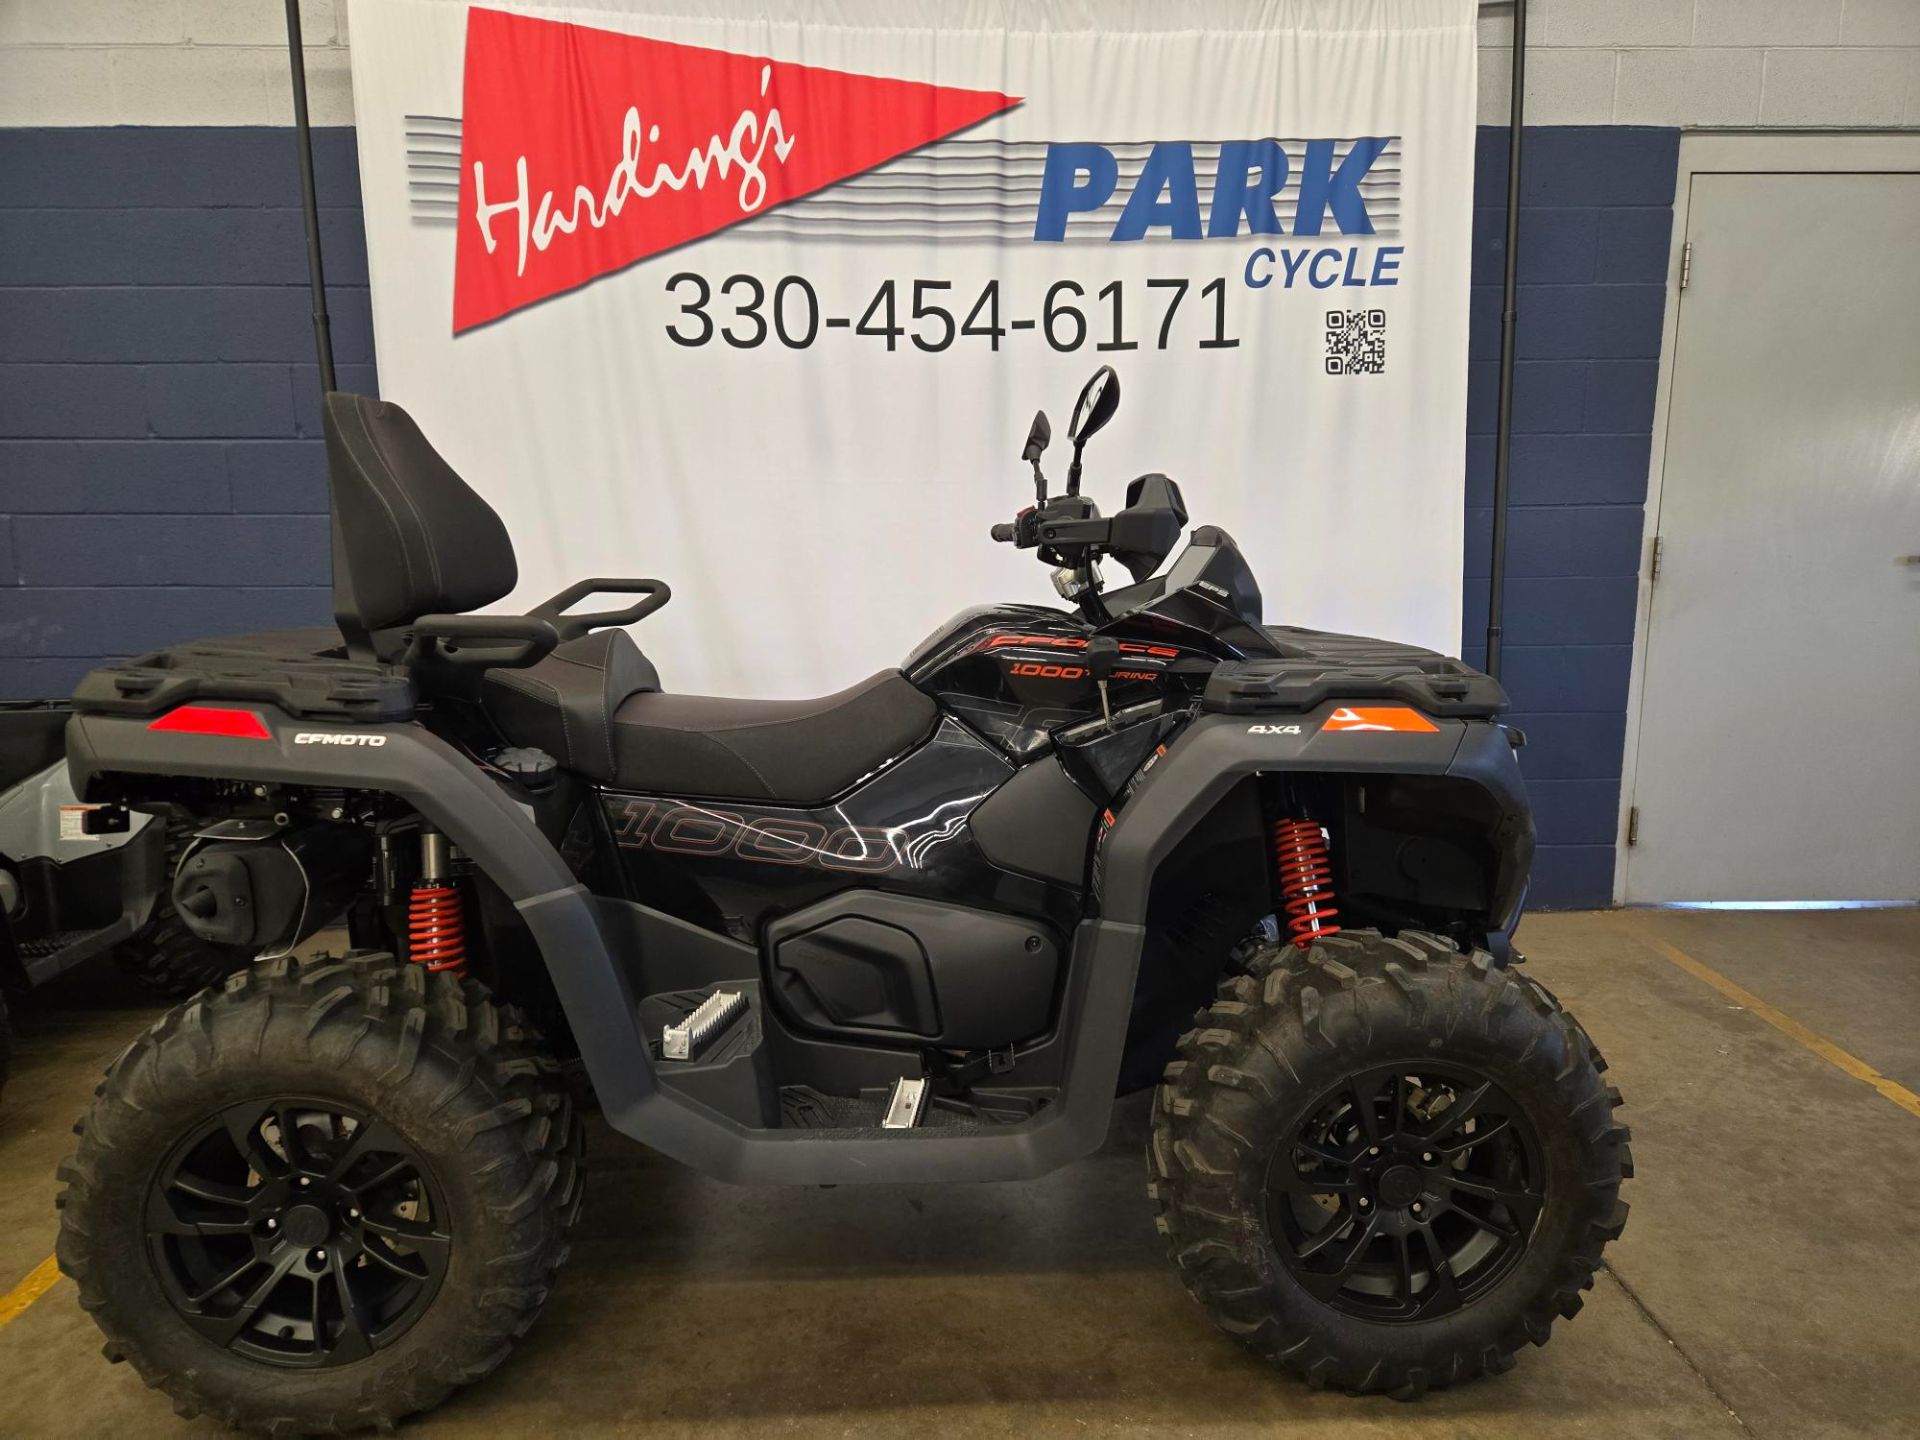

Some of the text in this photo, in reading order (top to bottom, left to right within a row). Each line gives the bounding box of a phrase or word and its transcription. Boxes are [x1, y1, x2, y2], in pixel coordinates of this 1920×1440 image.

[474, 64, 795, 277] Harding's
[1034, 138, 1391, 242] PARK
[1244, 246, 1404, 289] CYCLE
[664, 271, 1241, 354] 330-454-6171
[990, 634, 1180, 657] CFOCE
[1011, 663, 1084, 679] 1000
[294, 732, 387, 747] CFMOTO
[615, 801, 910, 873] 1000
